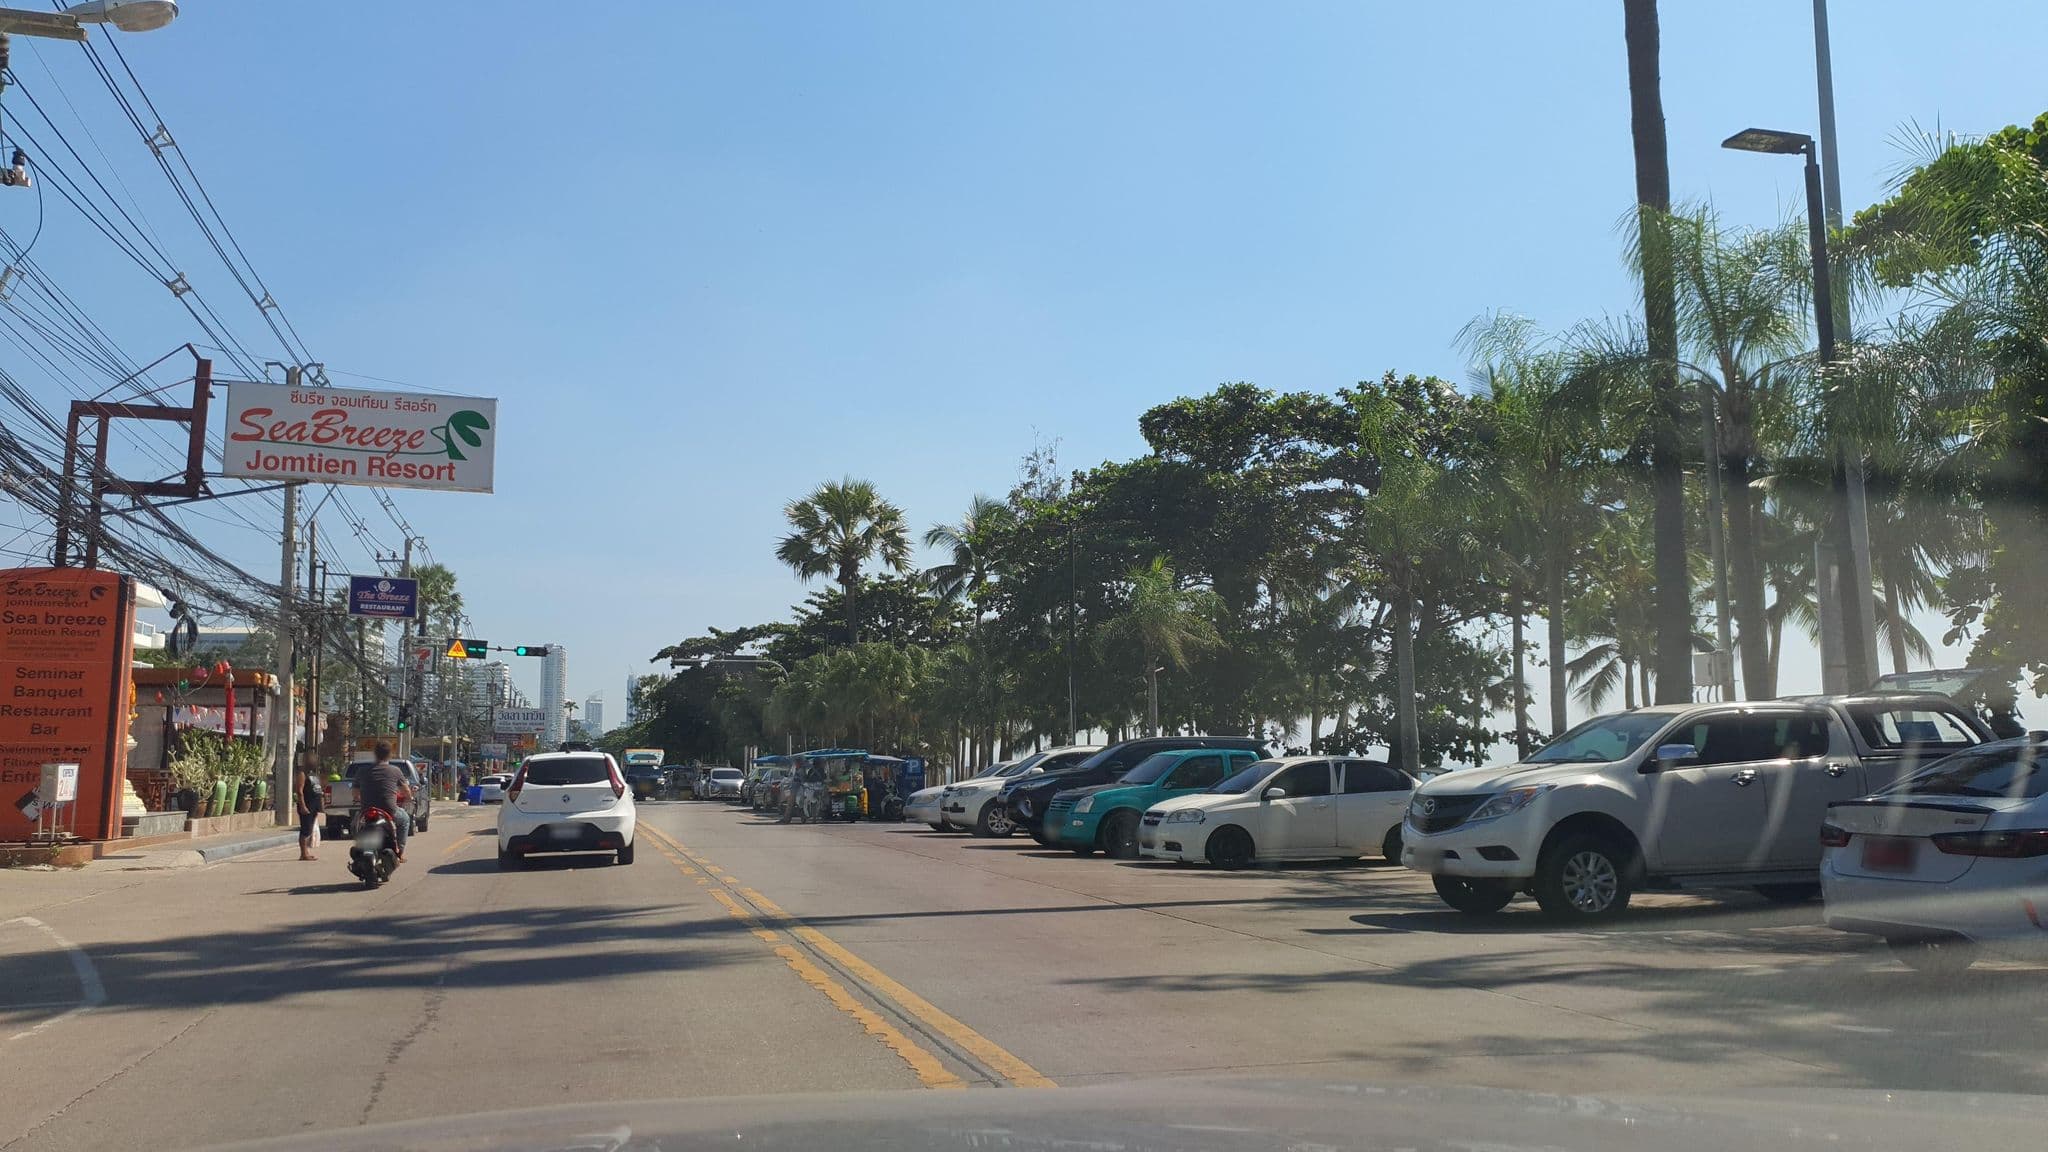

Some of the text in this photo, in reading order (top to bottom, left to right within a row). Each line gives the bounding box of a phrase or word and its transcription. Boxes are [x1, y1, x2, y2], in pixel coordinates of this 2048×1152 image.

[331, 394, 389, 410] จอมเทียน
[394, 397, 437, 413] รีสอร์ท
[246, 450, 456, 481] Jomtien Resort
[360, 603, 406, 612] RESTAURANT
[2, 610, 108, 626] Sea breeze
[7, 626, 101, 637] Jomtien Resort
[16, 667, 86, 680] Seminar
[14, 685, 84, 700] Banquet
[0, 704, 93, 718] Restaurant
[31, 723, 61, 736] Bar
